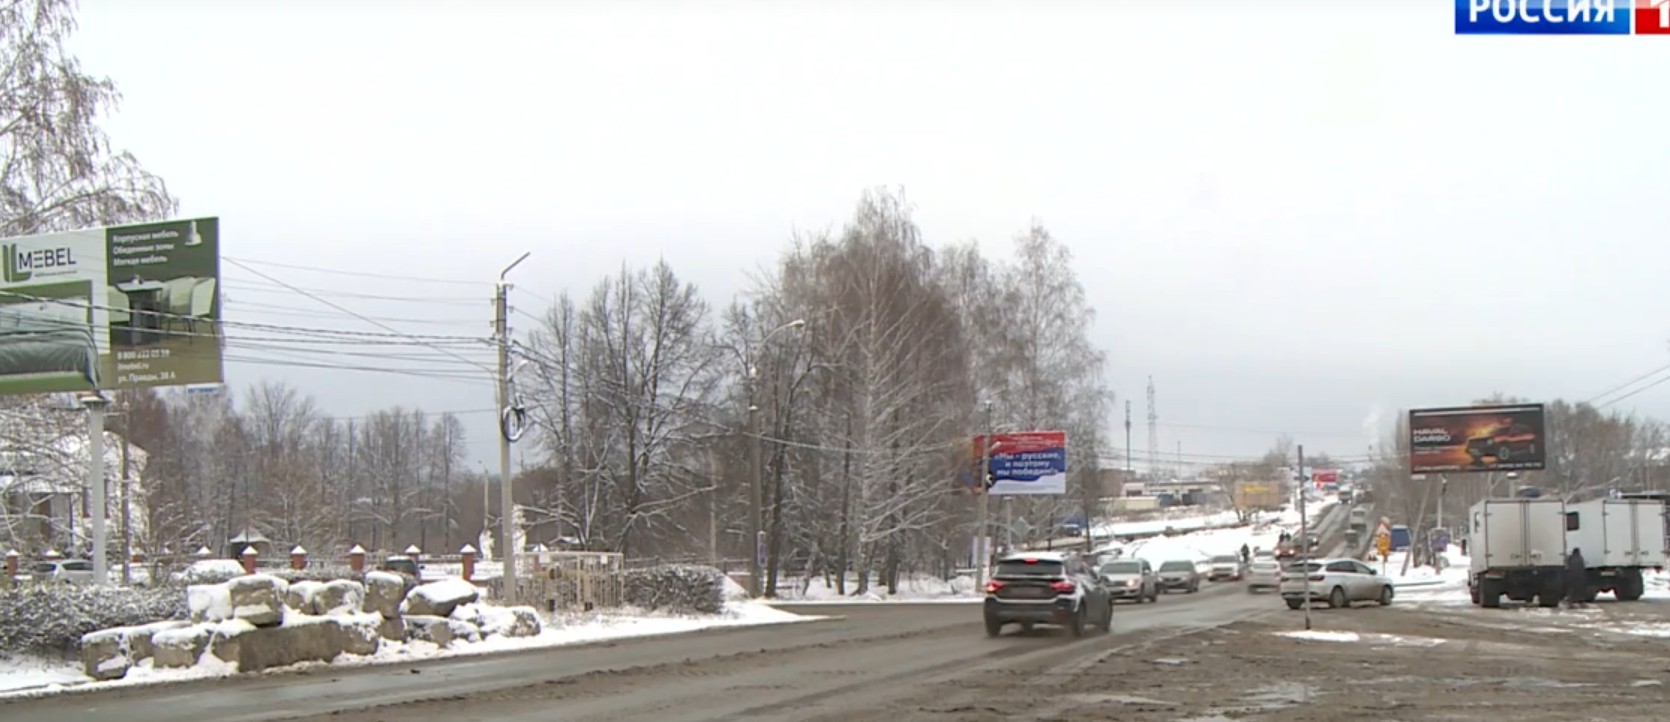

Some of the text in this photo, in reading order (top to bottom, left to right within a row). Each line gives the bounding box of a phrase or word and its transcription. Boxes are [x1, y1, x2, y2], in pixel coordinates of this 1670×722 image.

[112, 229, 179, 245] Корпусная мебель
[113, 254, 168, 267] Мягкая мебель
[123, 350, 136, 360] 800
[118, 375, 128, 384] ул.
[1013, 461, 1050, 469] поэтому
